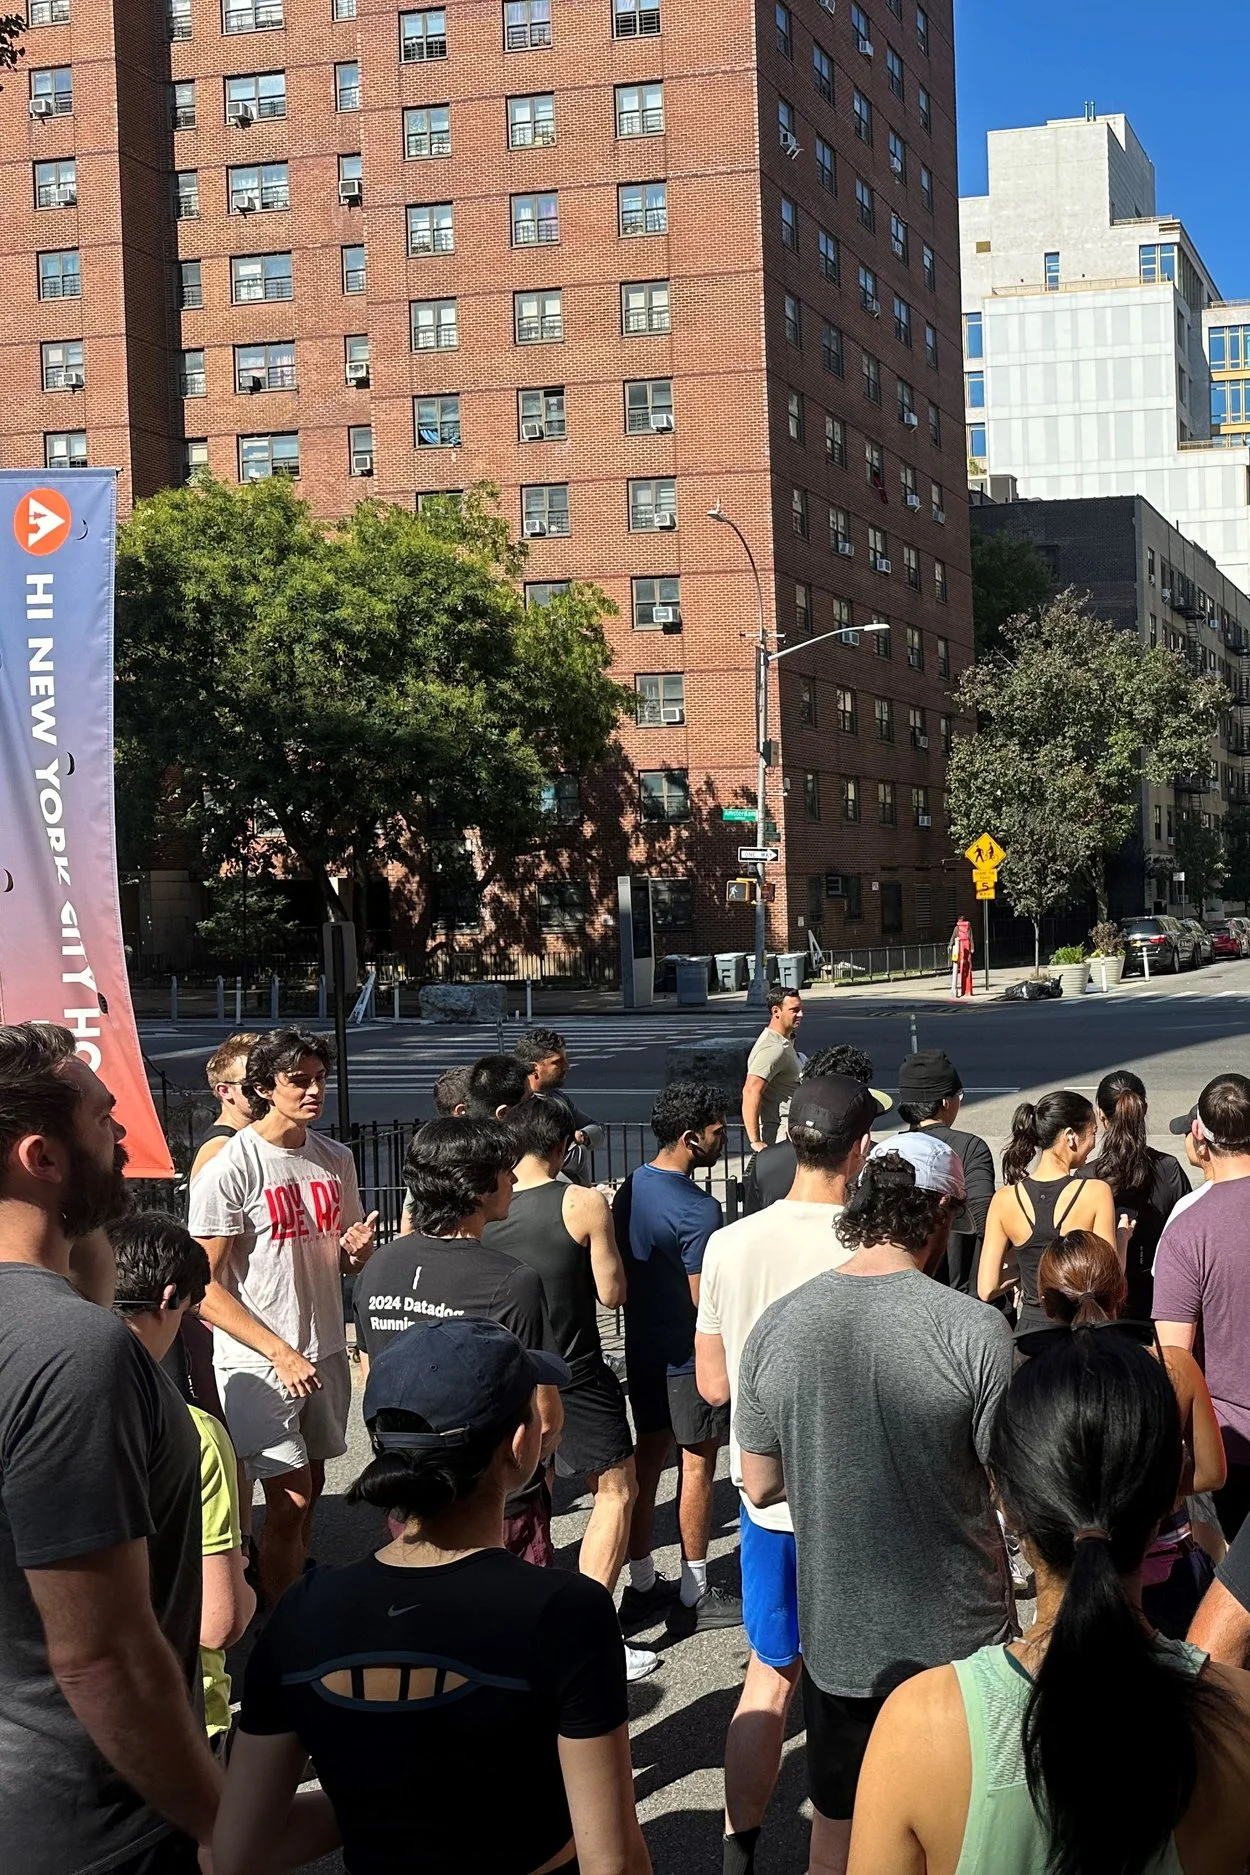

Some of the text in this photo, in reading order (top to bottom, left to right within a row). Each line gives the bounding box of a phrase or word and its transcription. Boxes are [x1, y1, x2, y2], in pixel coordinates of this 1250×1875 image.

[26, 573, 54, 620] HI
[28, 637, 57, 746] NEW
[35, 758, 71, 887] YORK
[982, 882, 989, 891] 5
[368, 1296, 402, 1310] 2024
